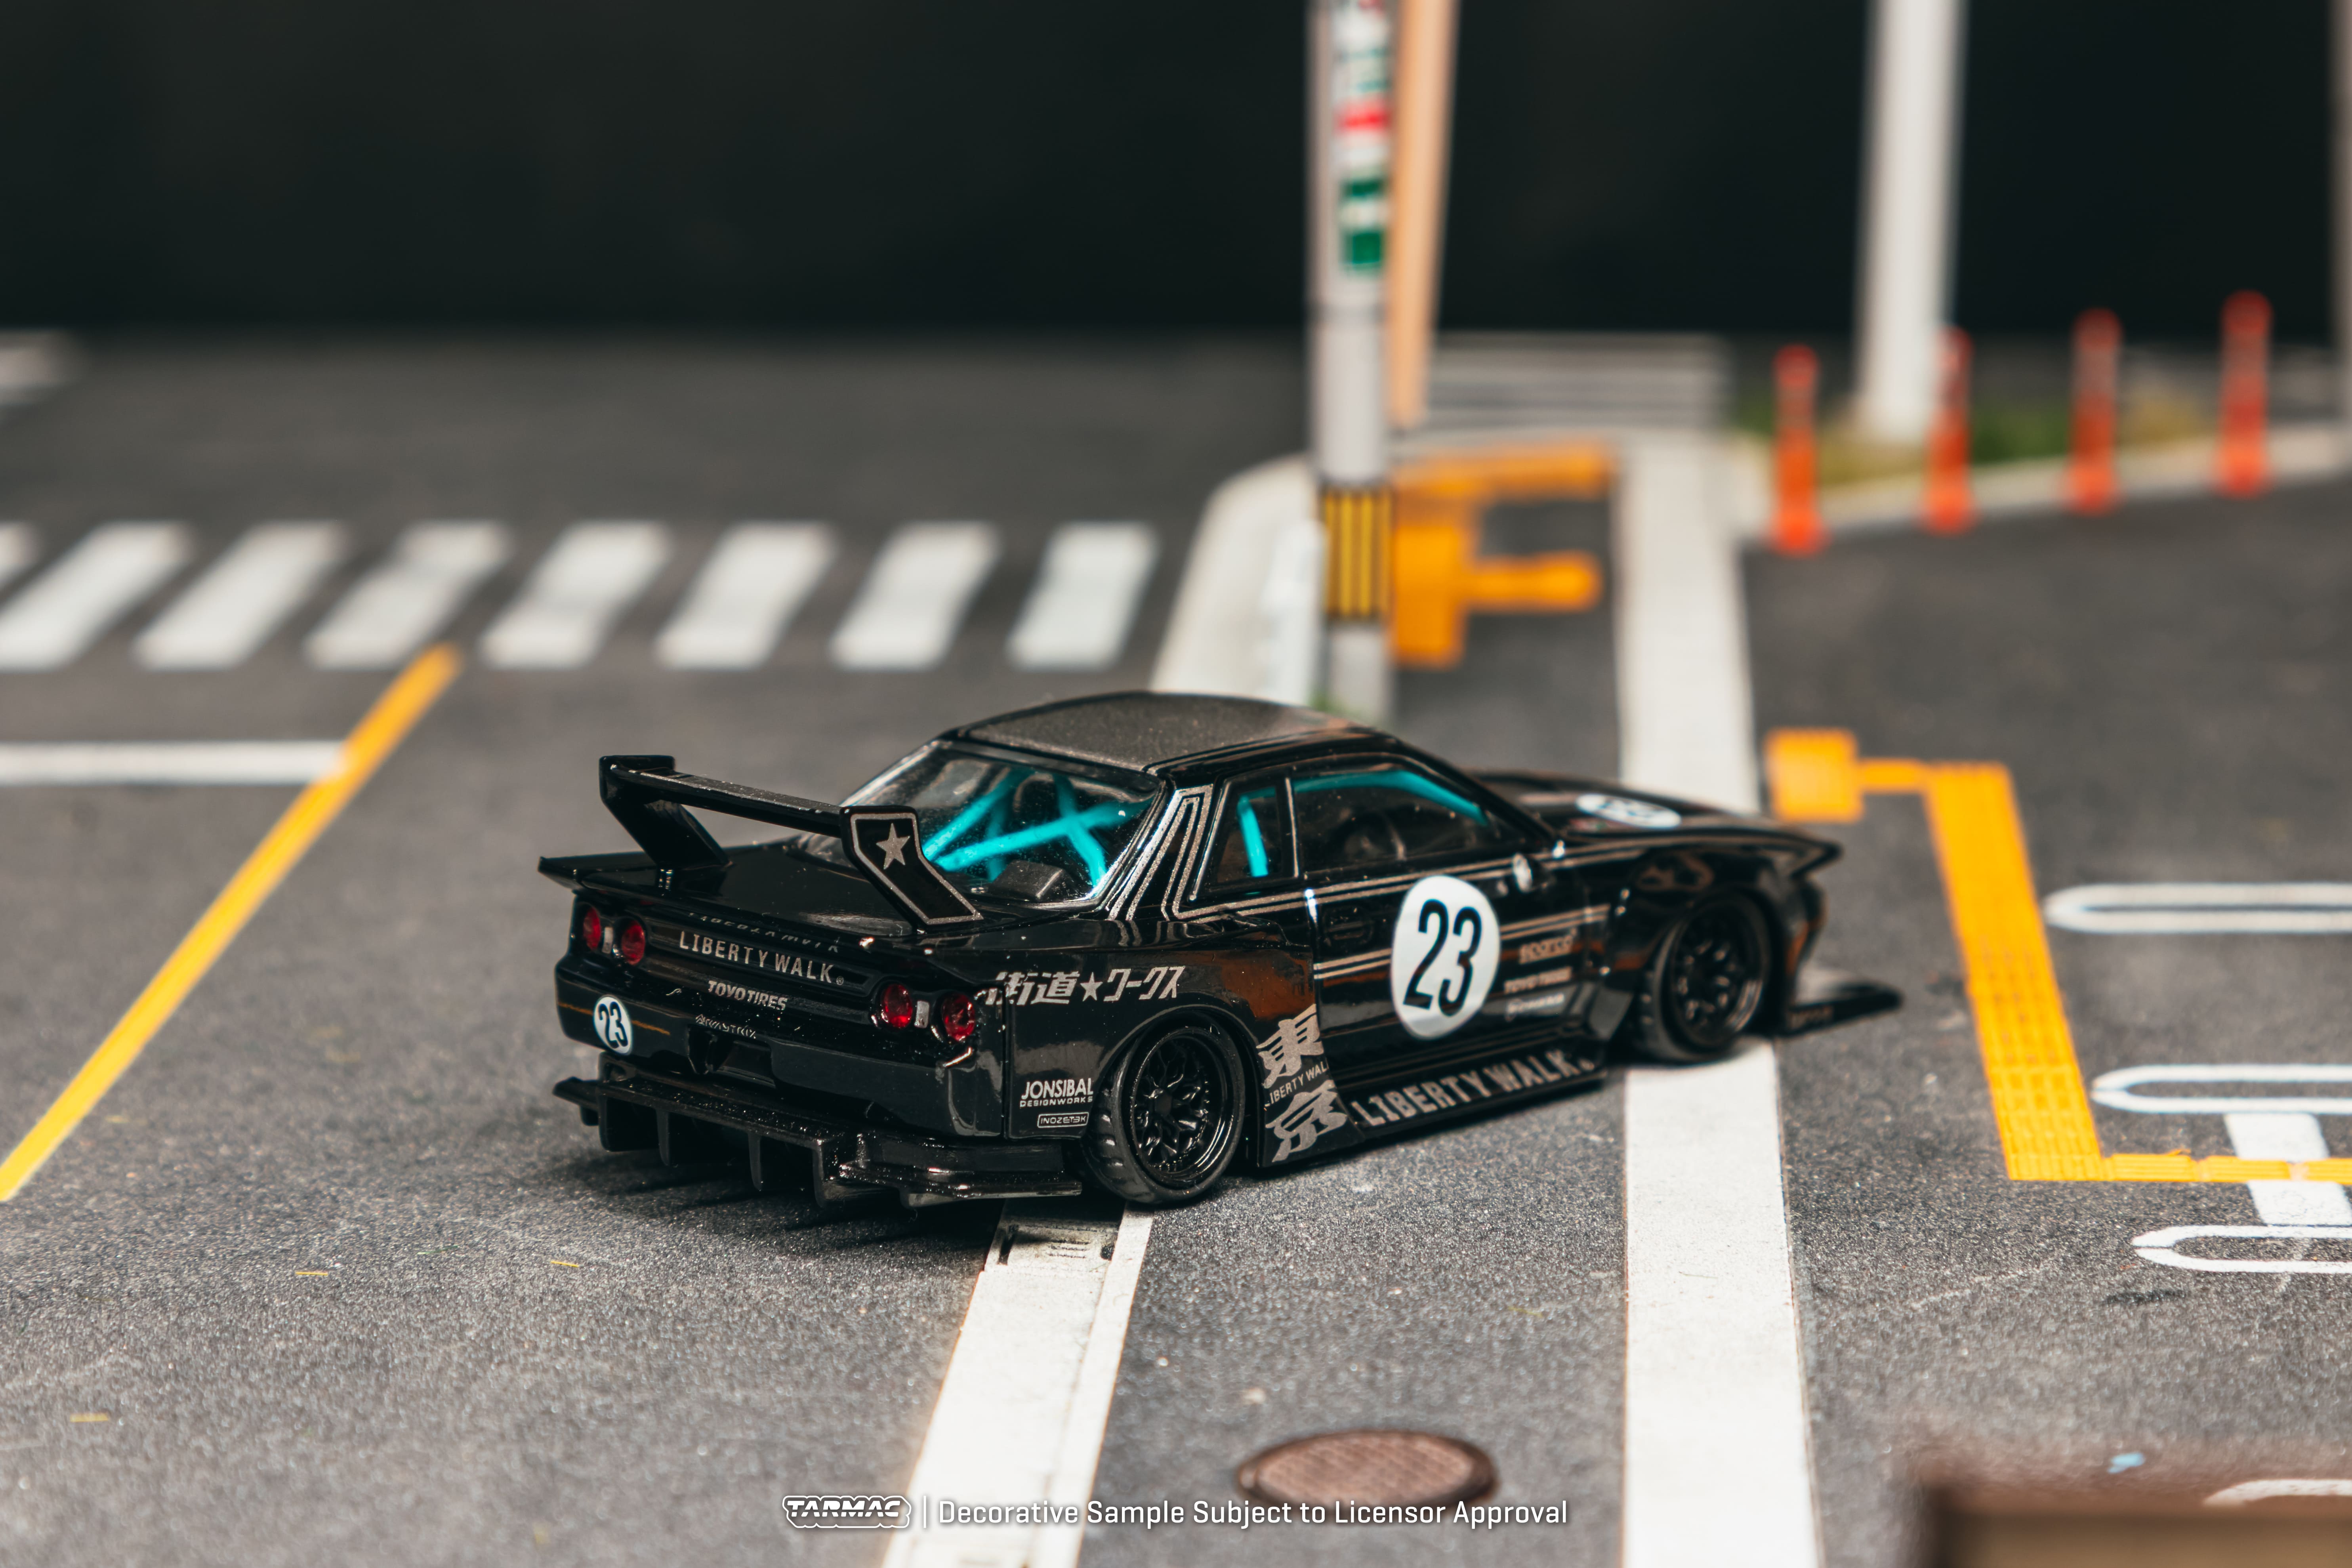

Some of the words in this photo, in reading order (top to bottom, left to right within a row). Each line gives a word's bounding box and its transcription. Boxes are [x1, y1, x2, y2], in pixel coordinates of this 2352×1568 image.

[680, 931, 768, 967] LIBERTY
[1403, 898, 1482, 1017] 23
[598, 1001, 628, 1048] 23
[1021, 1078, 1093, 1099] JONSIBAL
[1305, 1061, 1329, 1081] WAL
[1351, 1070, 1492, 1126] LIBERTY
